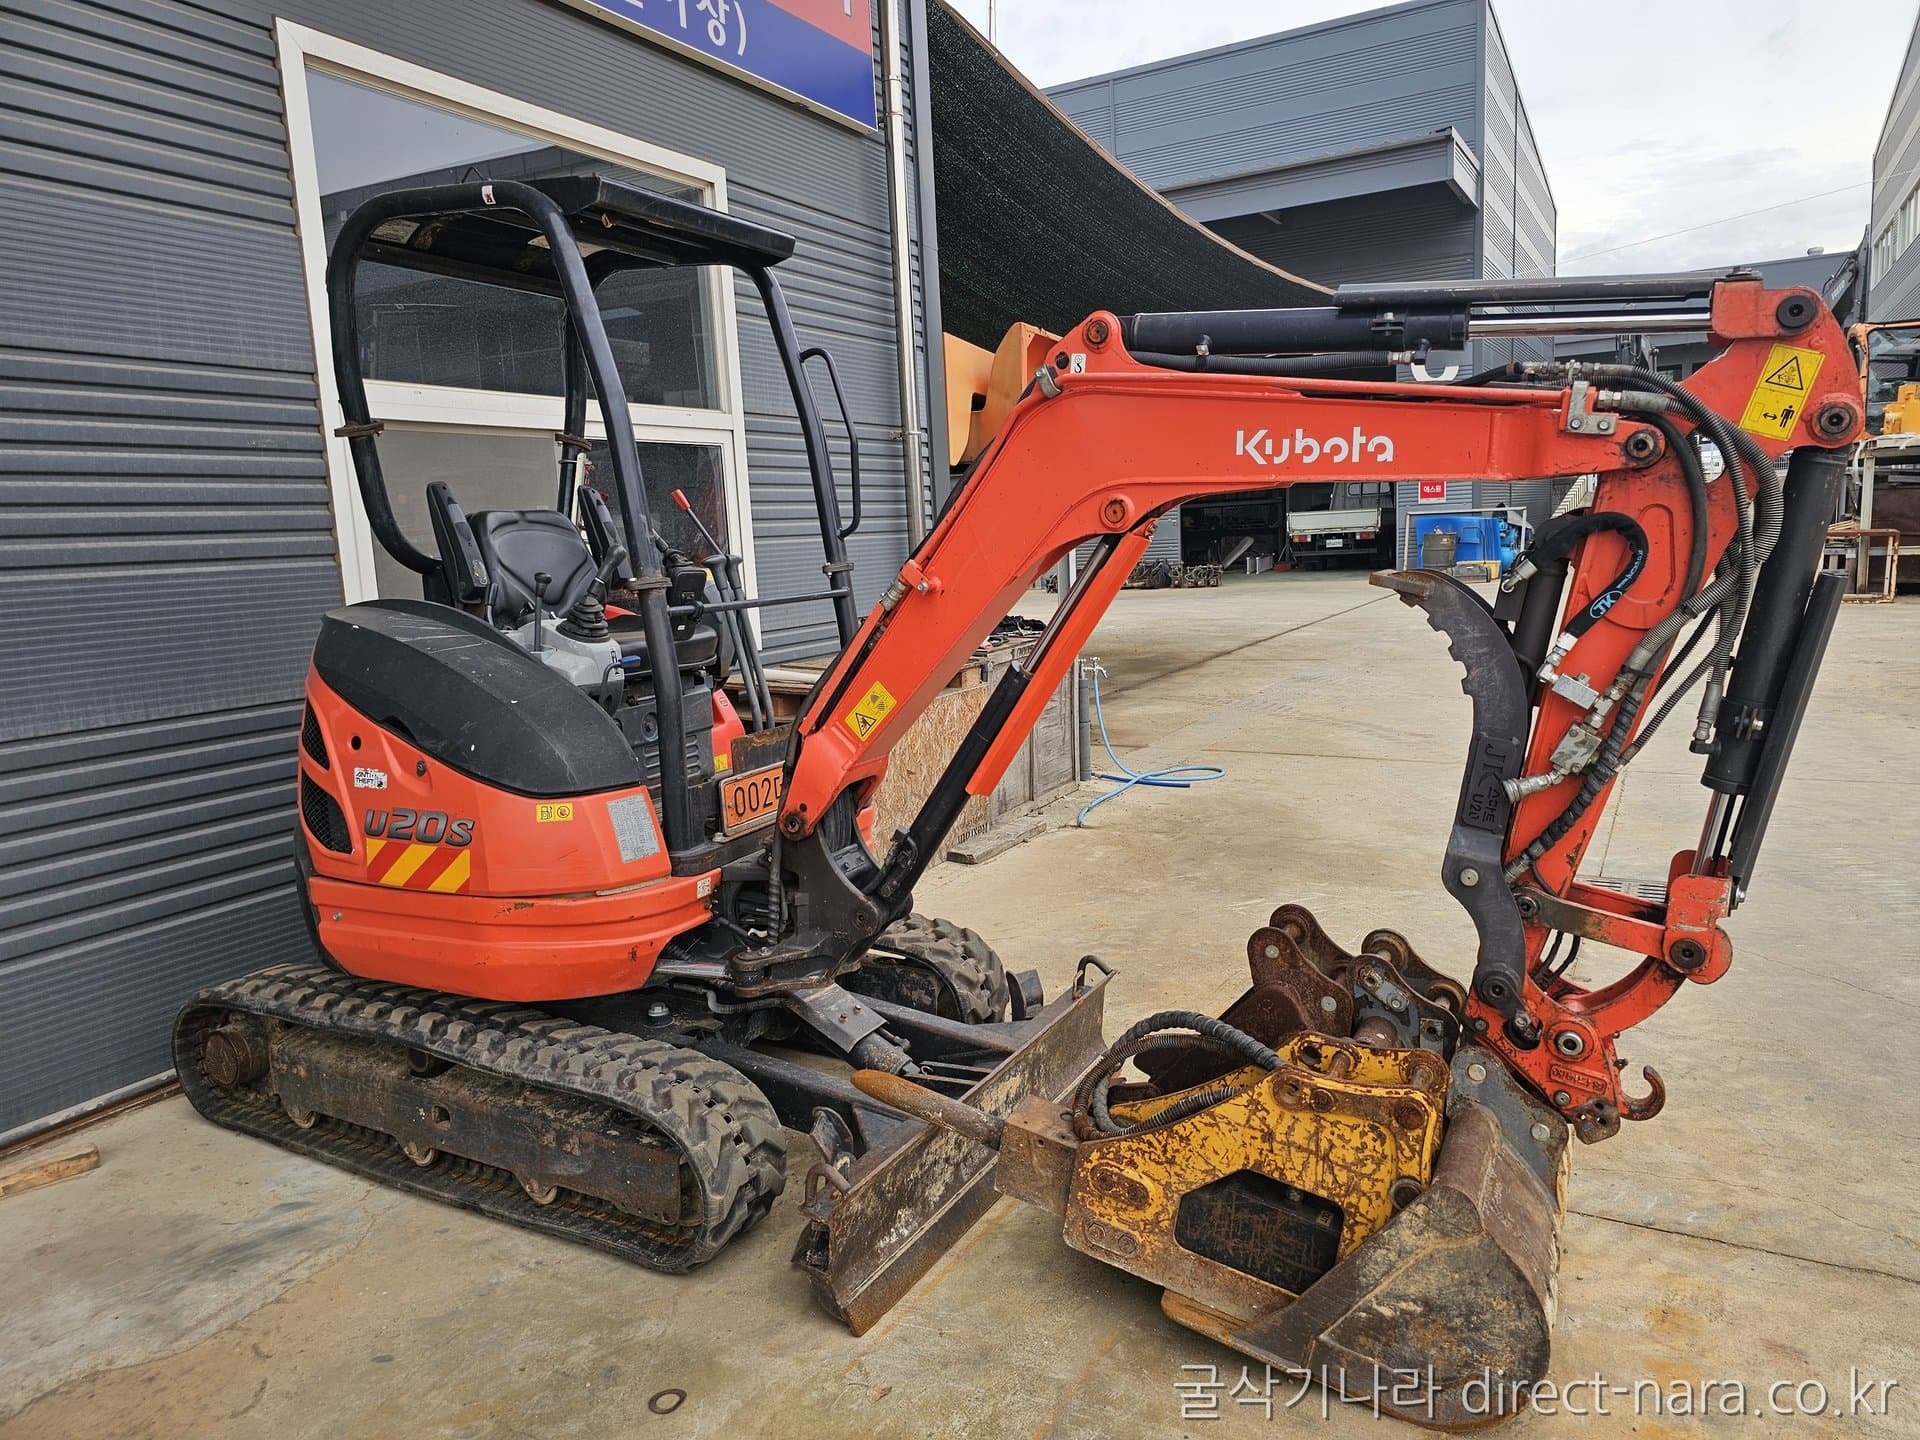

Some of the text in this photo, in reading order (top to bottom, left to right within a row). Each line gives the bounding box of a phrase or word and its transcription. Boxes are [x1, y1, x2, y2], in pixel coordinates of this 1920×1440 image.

[1235, 426, 1394, 465] Kubota
[1592, 593, 1616, 615] JK
[364, 807, 476, 847] U20S
